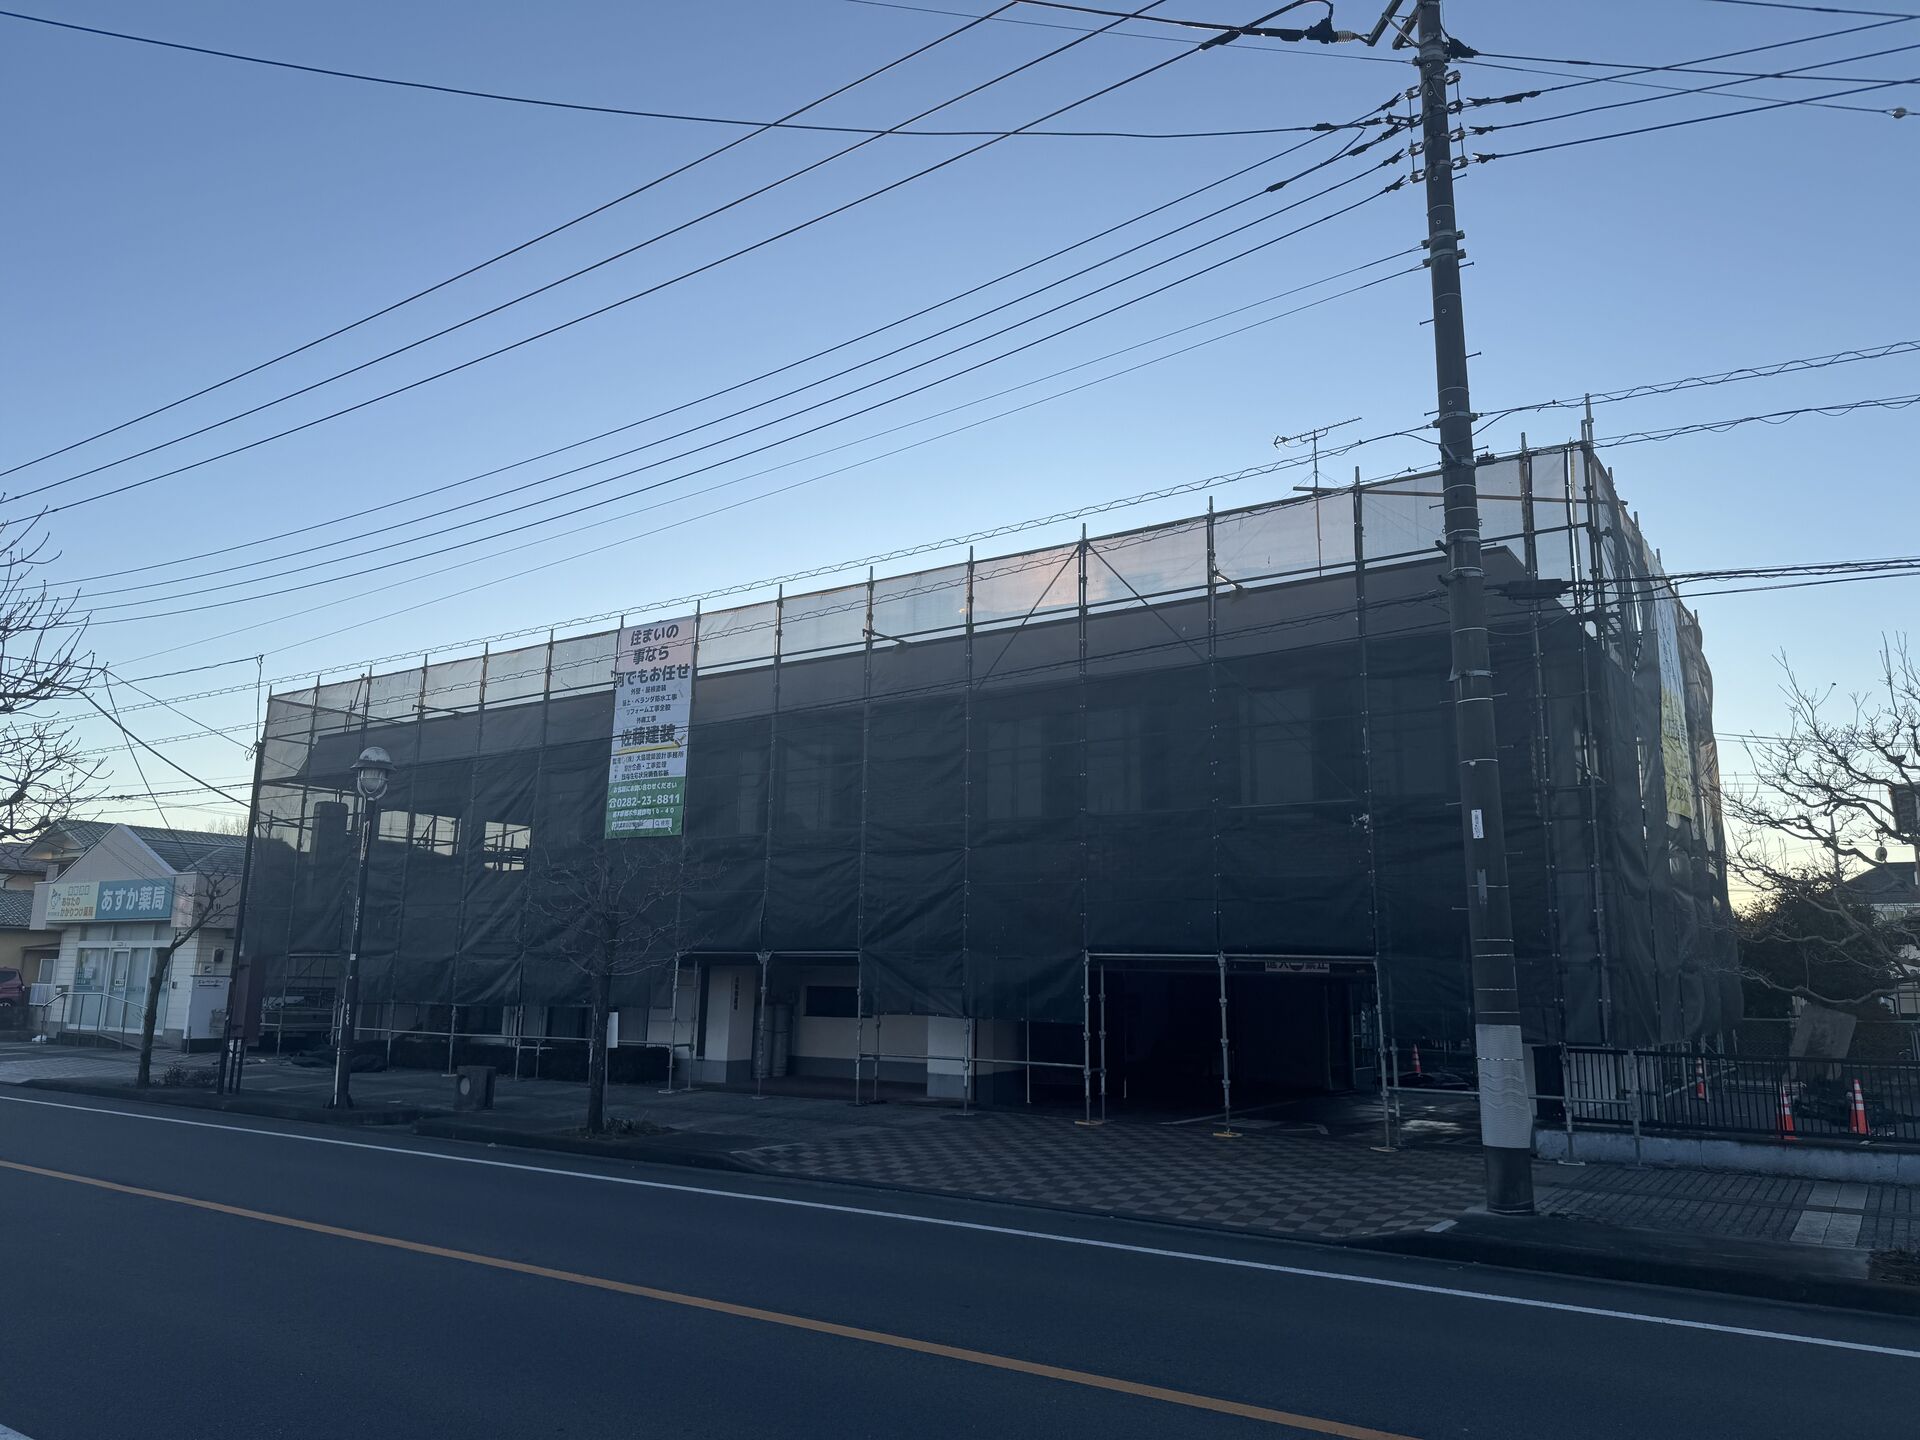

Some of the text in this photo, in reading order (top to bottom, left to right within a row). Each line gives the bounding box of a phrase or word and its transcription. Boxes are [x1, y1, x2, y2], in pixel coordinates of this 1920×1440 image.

[631, 624, 679, 646] 住まいの
[633, 646, 669, 665] 事なら
[611, 663, 690, 688] 何でもお任せ
[617, 794, 680, 808] 0282-23-8811
[101, 886, 165, 911] あすか薬局
